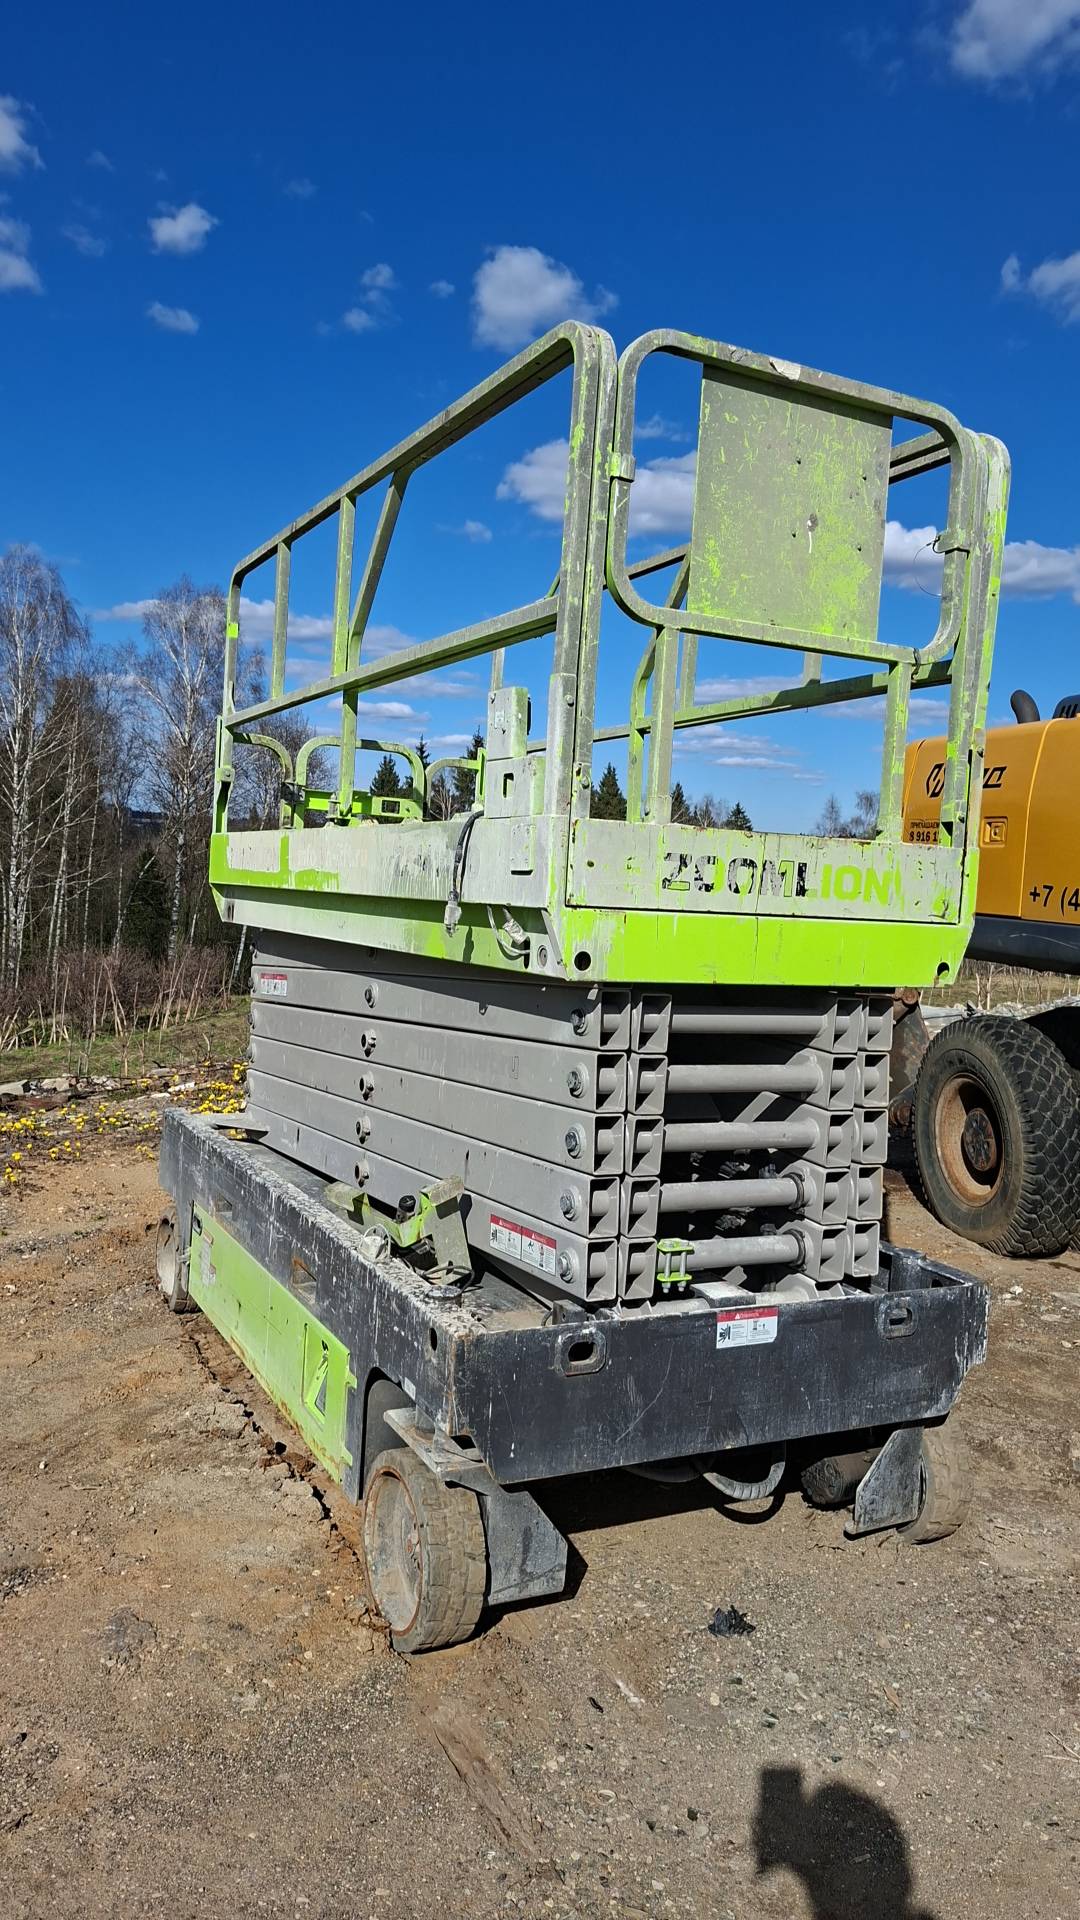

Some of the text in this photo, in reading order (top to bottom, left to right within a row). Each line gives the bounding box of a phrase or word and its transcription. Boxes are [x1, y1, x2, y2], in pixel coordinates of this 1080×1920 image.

[916, 831, 931, 841] 916
[662, 852, 892, 906] ZOOMLION
[1029, 884, 1054, 907] +7
